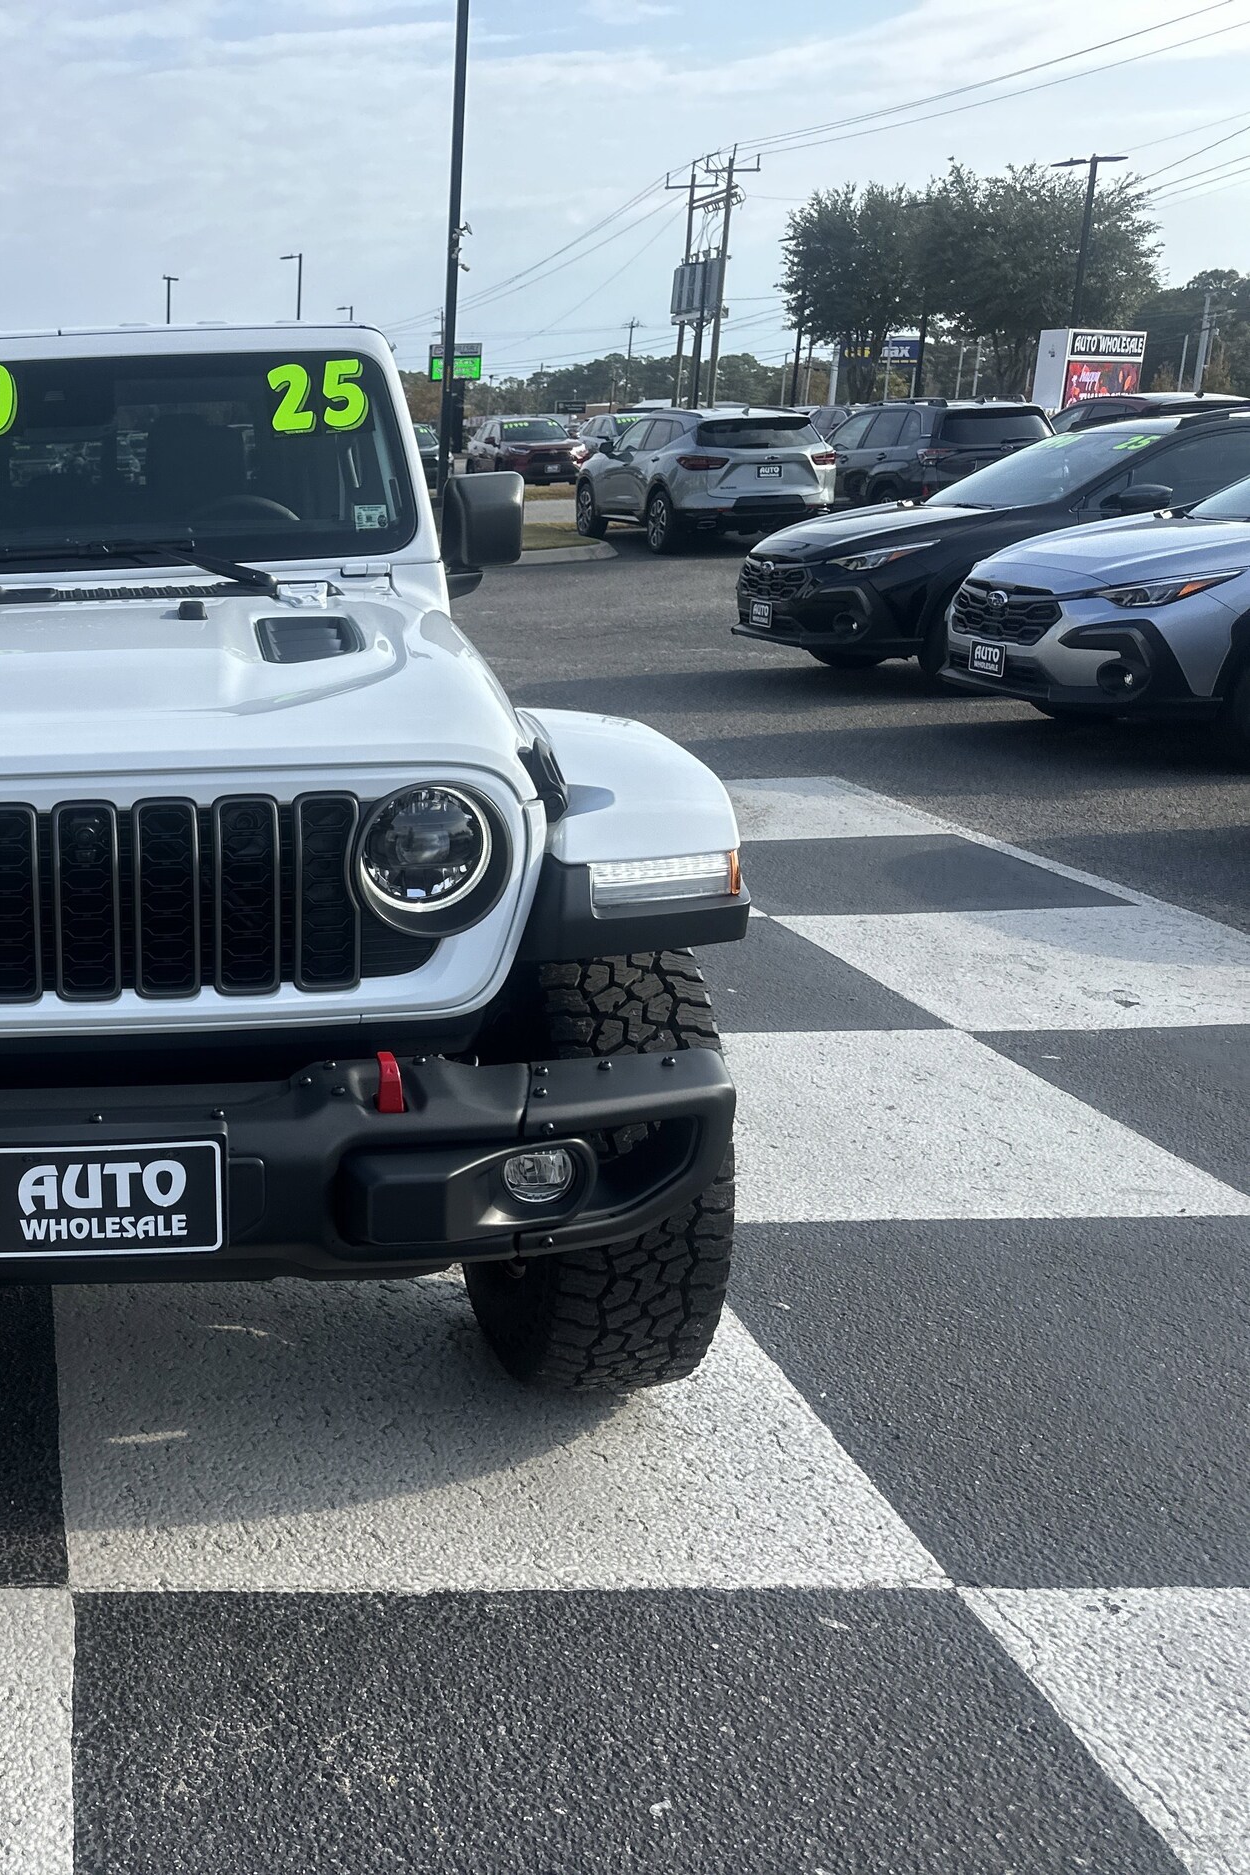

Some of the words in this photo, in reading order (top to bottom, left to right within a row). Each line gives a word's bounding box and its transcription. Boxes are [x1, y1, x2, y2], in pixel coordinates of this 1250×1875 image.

[1074, 335, 1097, 352] AUTO
[1099, 336, 1144, 354] WHOLESALE
[1079, 364, 1101, 391] happy
[267, 358, 369, 434] 25
[1112, 435, 1162, 449] 25
[759, 466, 780, 474] AUTO
[974, 645, 1000, 663] AUTO
[17, 1159, 187, 1216] AUTO
[19, 1214, 188, 1243] WHOLESALE
